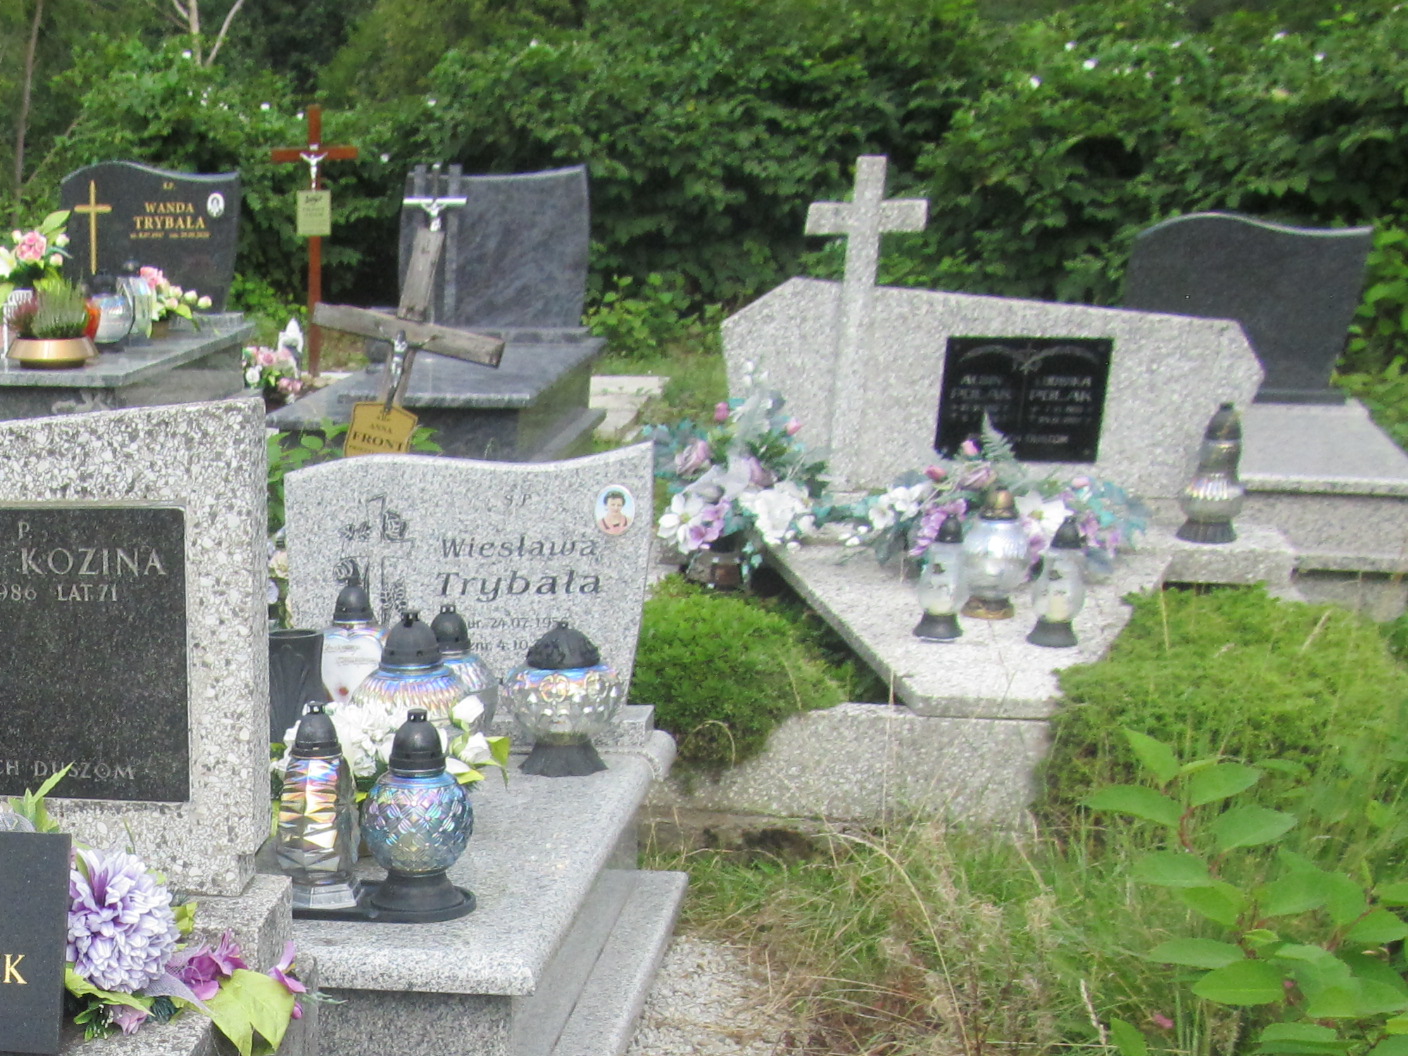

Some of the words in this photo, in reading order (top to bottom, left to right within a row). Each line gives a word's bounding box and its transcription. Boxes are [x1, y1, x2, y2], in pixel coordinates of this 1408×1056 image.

[145, 201, 195, 213] WANDA
[21, 547, 167, 577] KOZINA
[34, 760, 135, 780] DUSZOM
